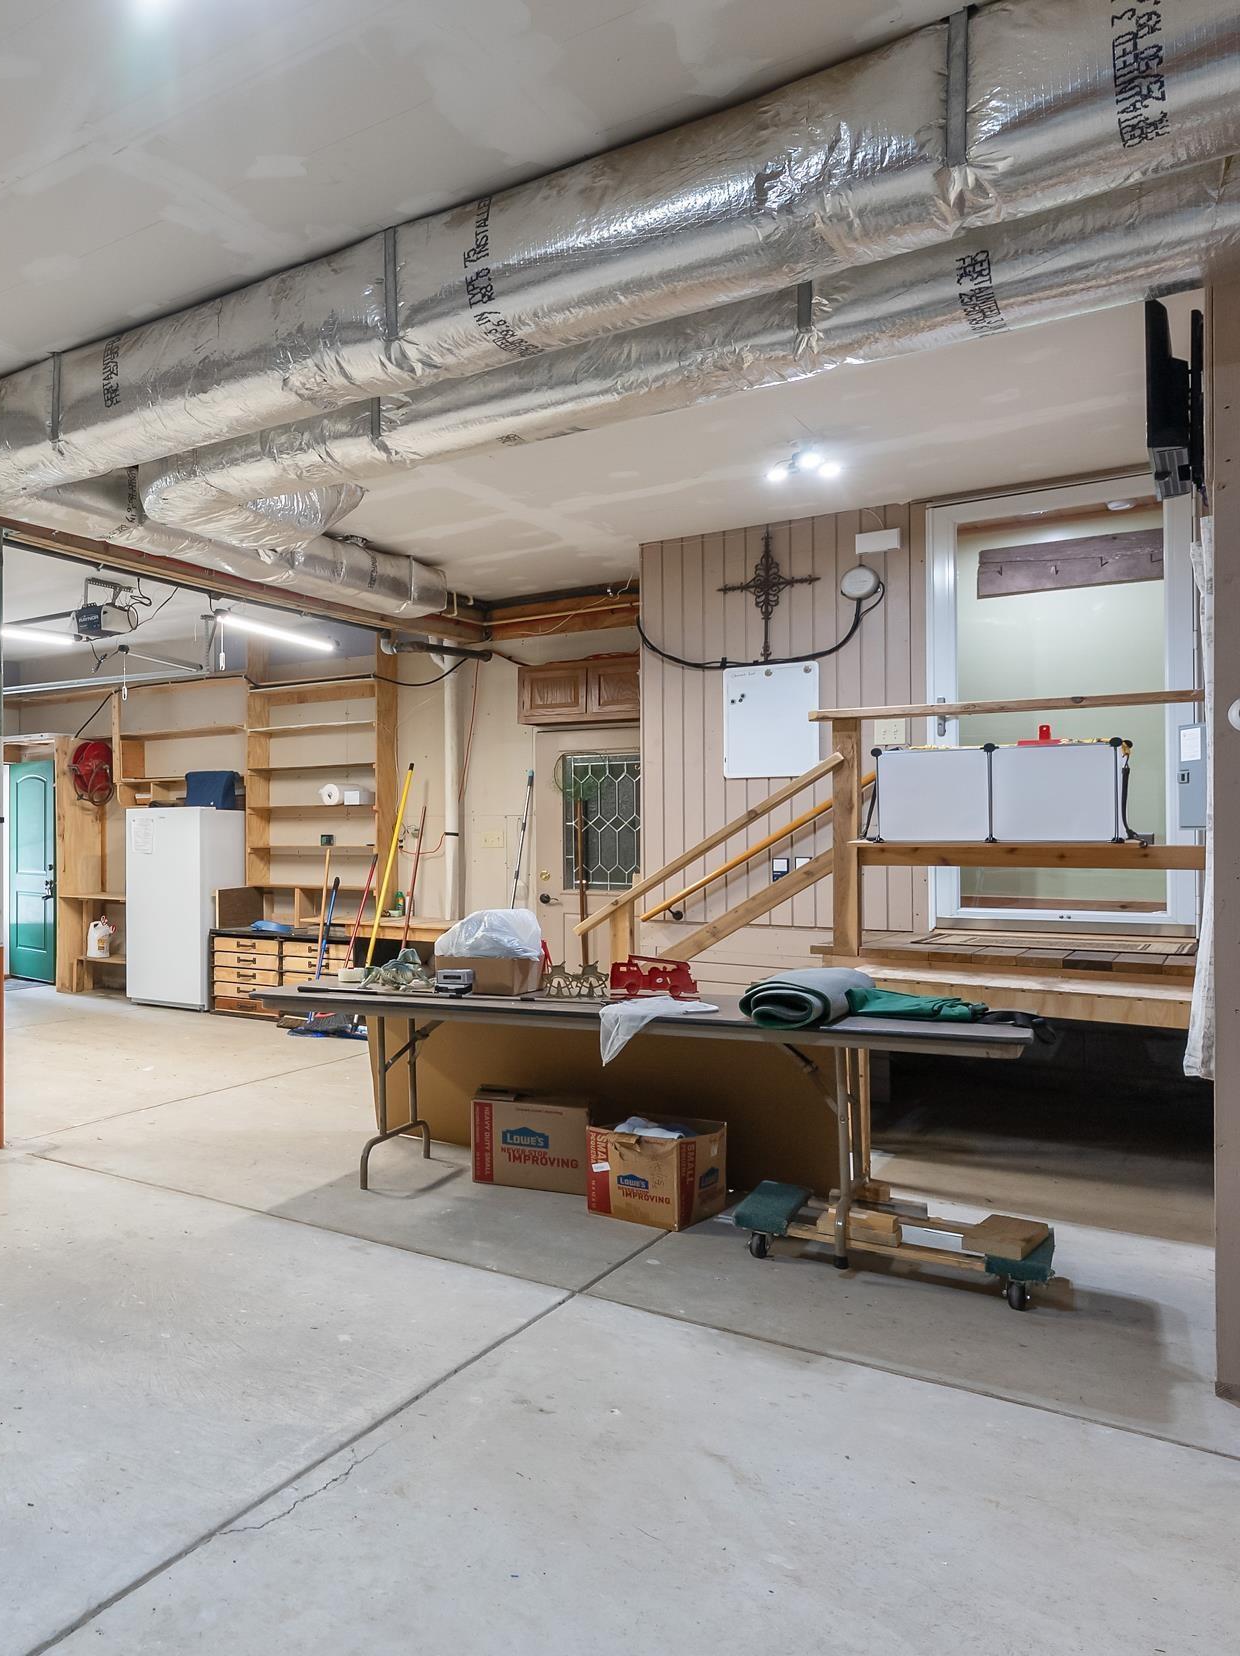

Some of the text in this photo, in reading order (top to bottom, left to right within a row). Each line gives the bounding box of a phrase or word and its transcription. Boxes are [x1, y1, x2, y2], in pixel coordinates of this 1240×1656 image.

[474, 198, 492, 263] INSTALLE
[463, 248, 480, 269] 75
[465, 269, 484, 309] TYPE
[474, 310, 491, 327] IN
[506, 1132, 545, 1147] LOWE'S
[596, 1134, 609, 1163] SMA
[507, 1150, 579, 1169] IMPROVING
[686, 1143, 695, 1185] SMALL
[622, 1189, 671, 1205] IMPROVING
